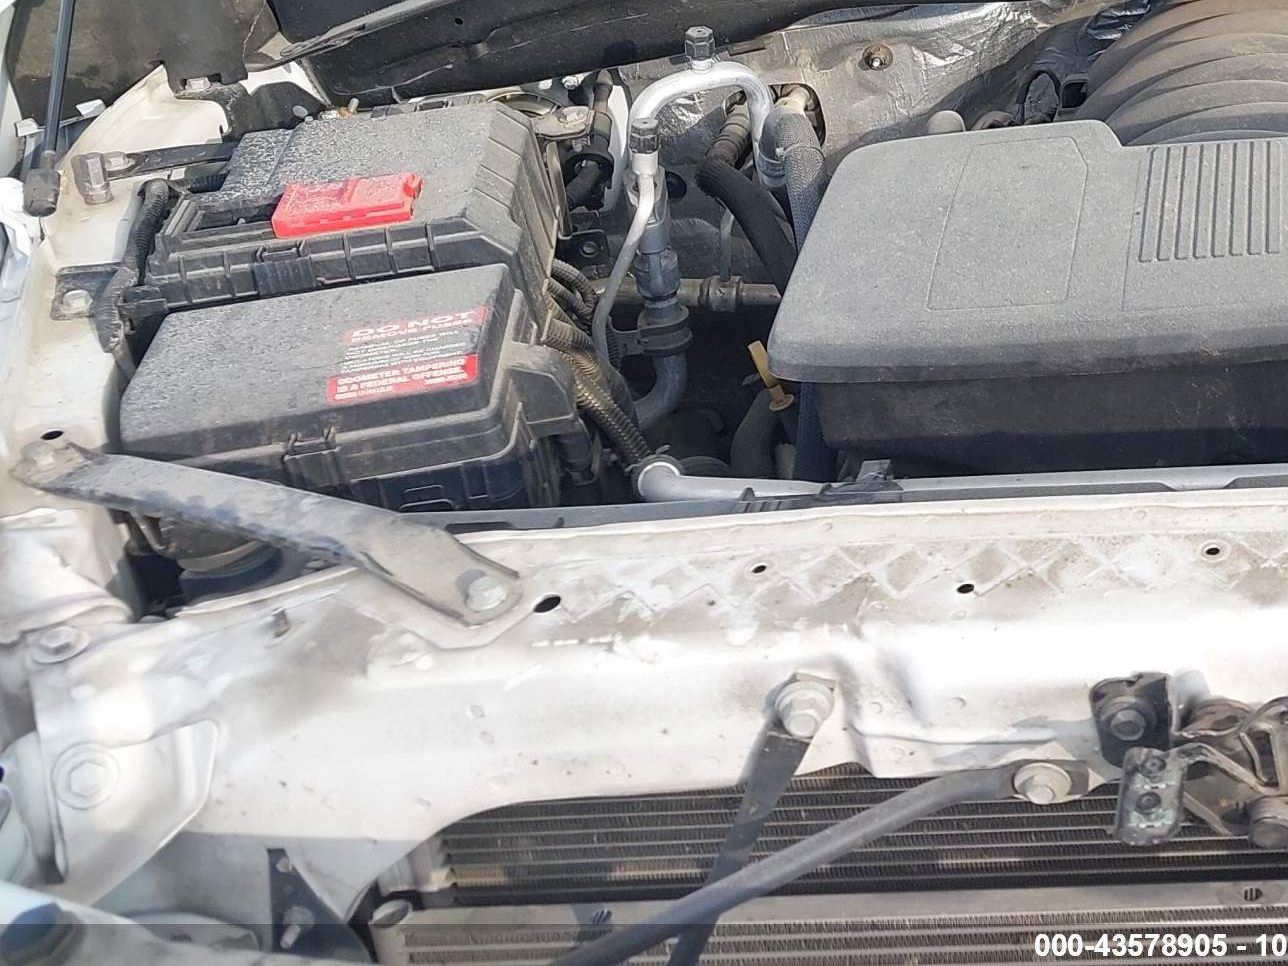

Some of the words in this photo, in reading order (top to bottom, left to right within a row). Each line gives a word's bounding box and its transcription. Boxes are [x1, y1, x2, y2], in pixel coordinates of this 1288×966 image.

[352, 324, 400, 337] DO
[408, 311, 474, 329] NOT
[337, 369, 401, 384] ODOMETER
[402, 359, 465, 374] TAMPERING
[337, 385, 350, 393] IS
[360, 376, 411, 389] FEDERAL
